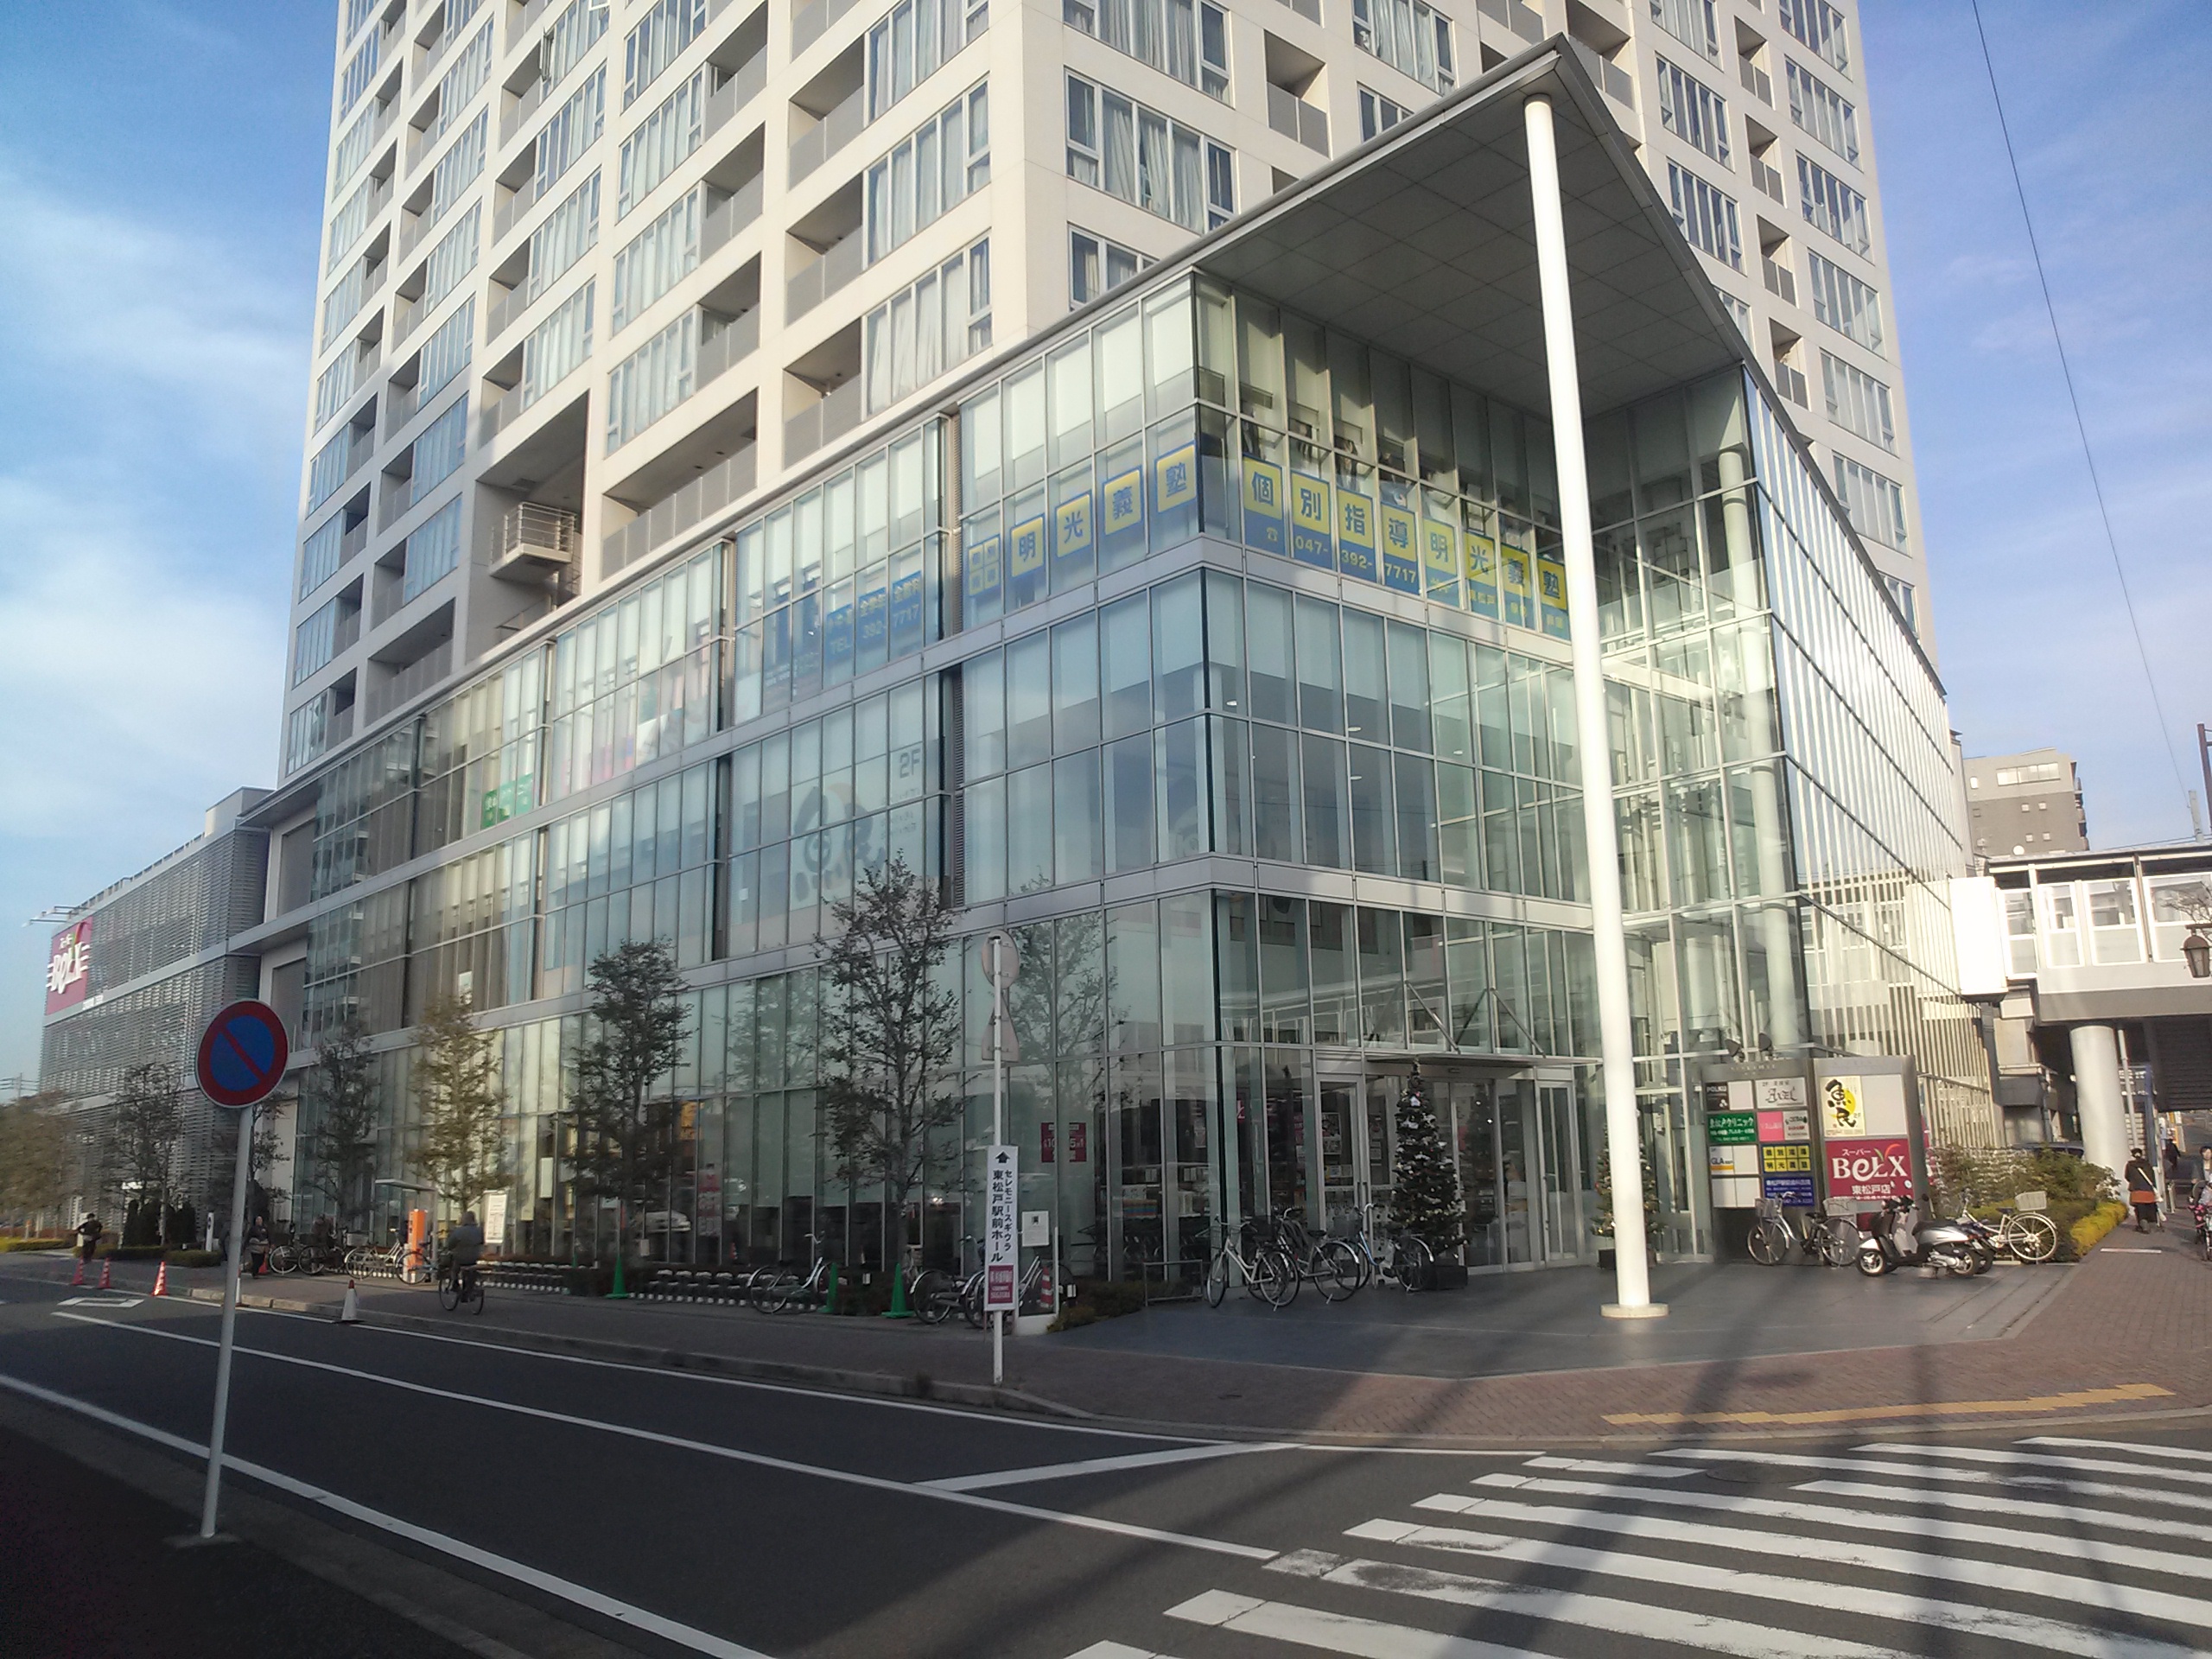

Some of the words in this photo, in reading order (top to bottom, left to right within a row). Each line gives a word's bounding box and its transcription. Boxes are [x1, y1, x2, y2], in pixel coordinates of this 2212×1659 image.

[1018, 461, 1188, 563] 明光義塾
[899, 748, 921, 778] 2F
[1825, 1078, 1857, 1128] 魚民
[1842, 1147, 1872, 1156] スーパー
[1004, 1169, 1014, 1252] セレモニースギウラ
[1852, 1184, 1891, 1195] 東松戸店
[990, 1169, 1004, 1263] 東松戸駅前ホール
